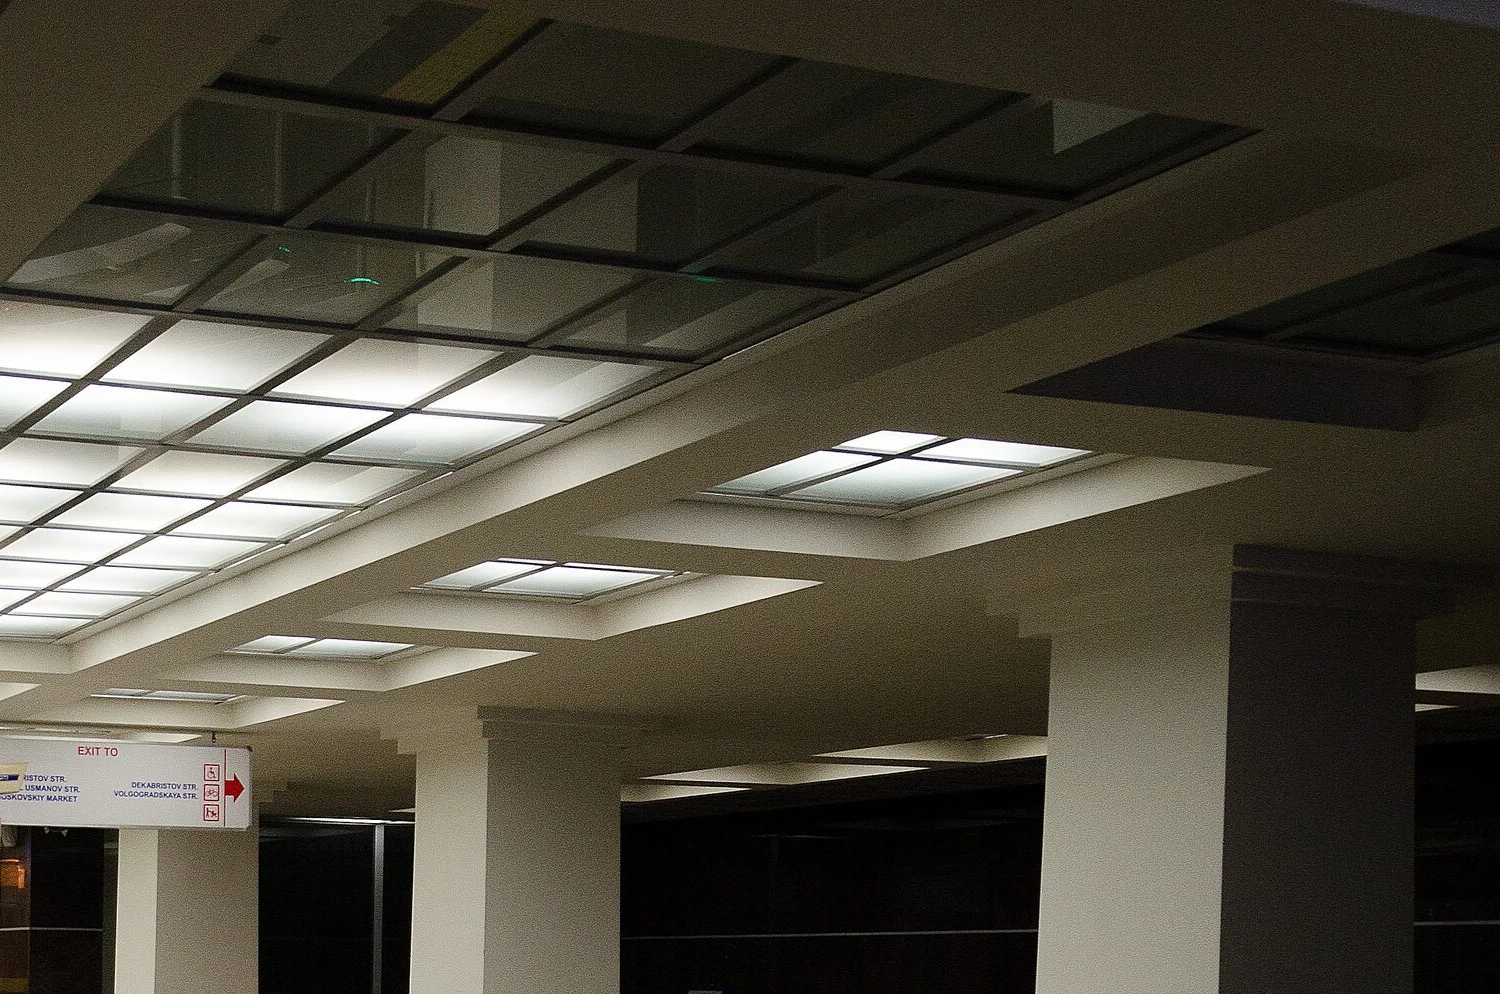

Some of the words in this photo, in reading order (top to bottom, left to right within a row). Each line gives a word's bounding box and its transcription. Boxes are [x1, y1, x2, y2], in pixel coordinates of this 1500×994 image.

[78, 747, 102, 756] EXIT
[104, 747, 118, 757] TO
[26, 785, 62, 793] USMANOV
[114, 790, 181, 800] VOLGOGRADSKAYA
